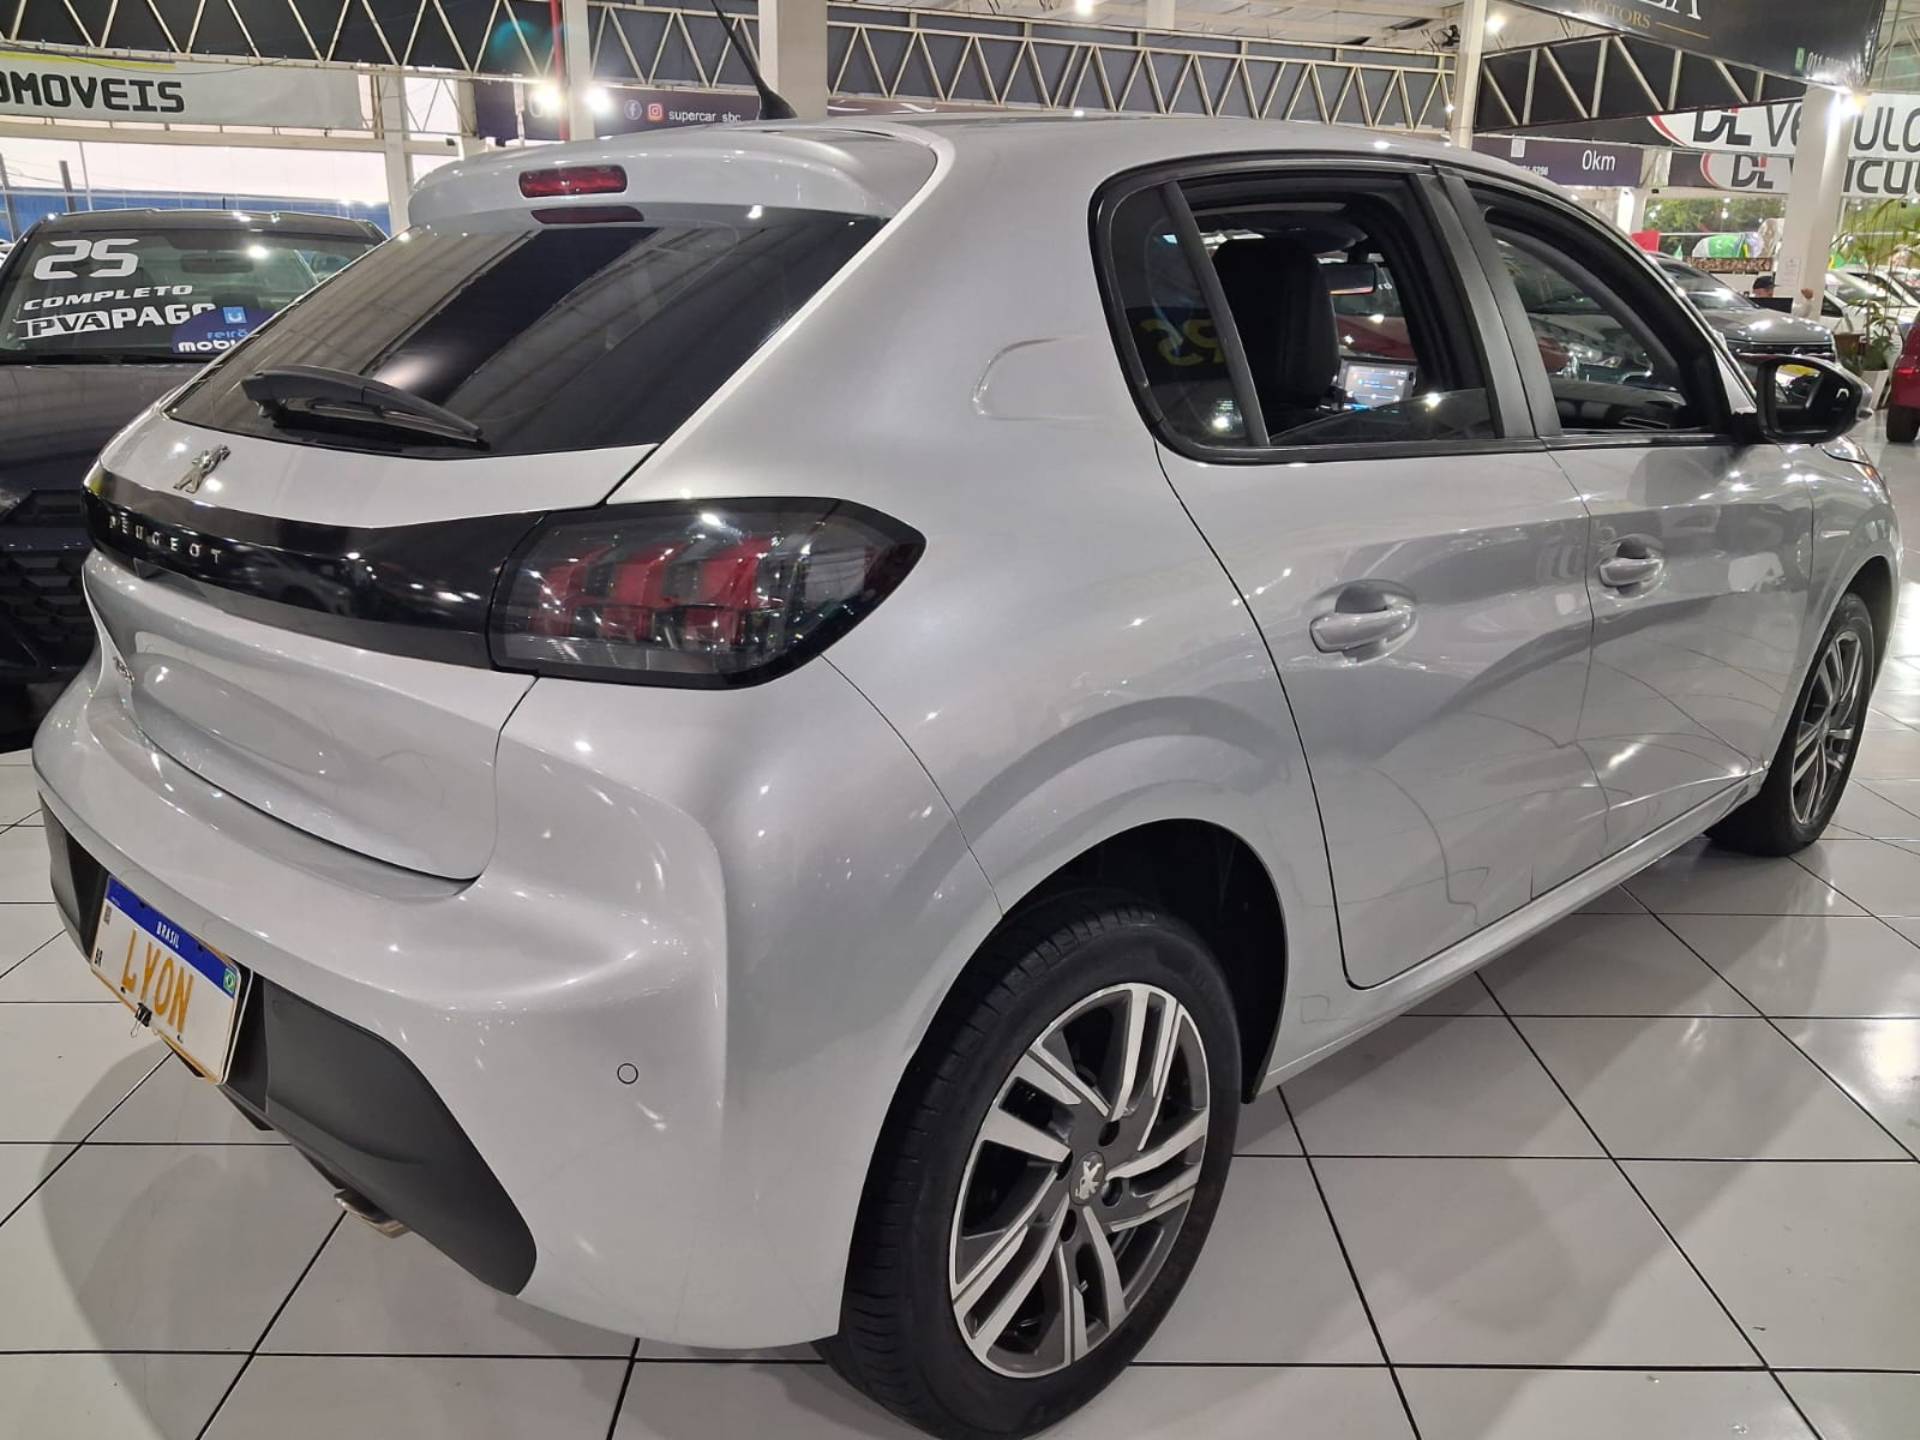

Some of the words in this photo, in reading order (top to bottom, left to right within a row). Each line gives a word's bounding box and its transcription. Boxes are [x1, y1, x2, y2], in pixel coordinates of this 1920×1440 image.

[1582, 150, 1616, 171] 0km
[33, 238, 139, 280] 25
[23, 284, 193, 311] COMPLETO
[108, 512, 222, 564] PEUGEOT
[156, 921, 180, 949] BRASIL
[121, 928, 194, 1035] LYON
